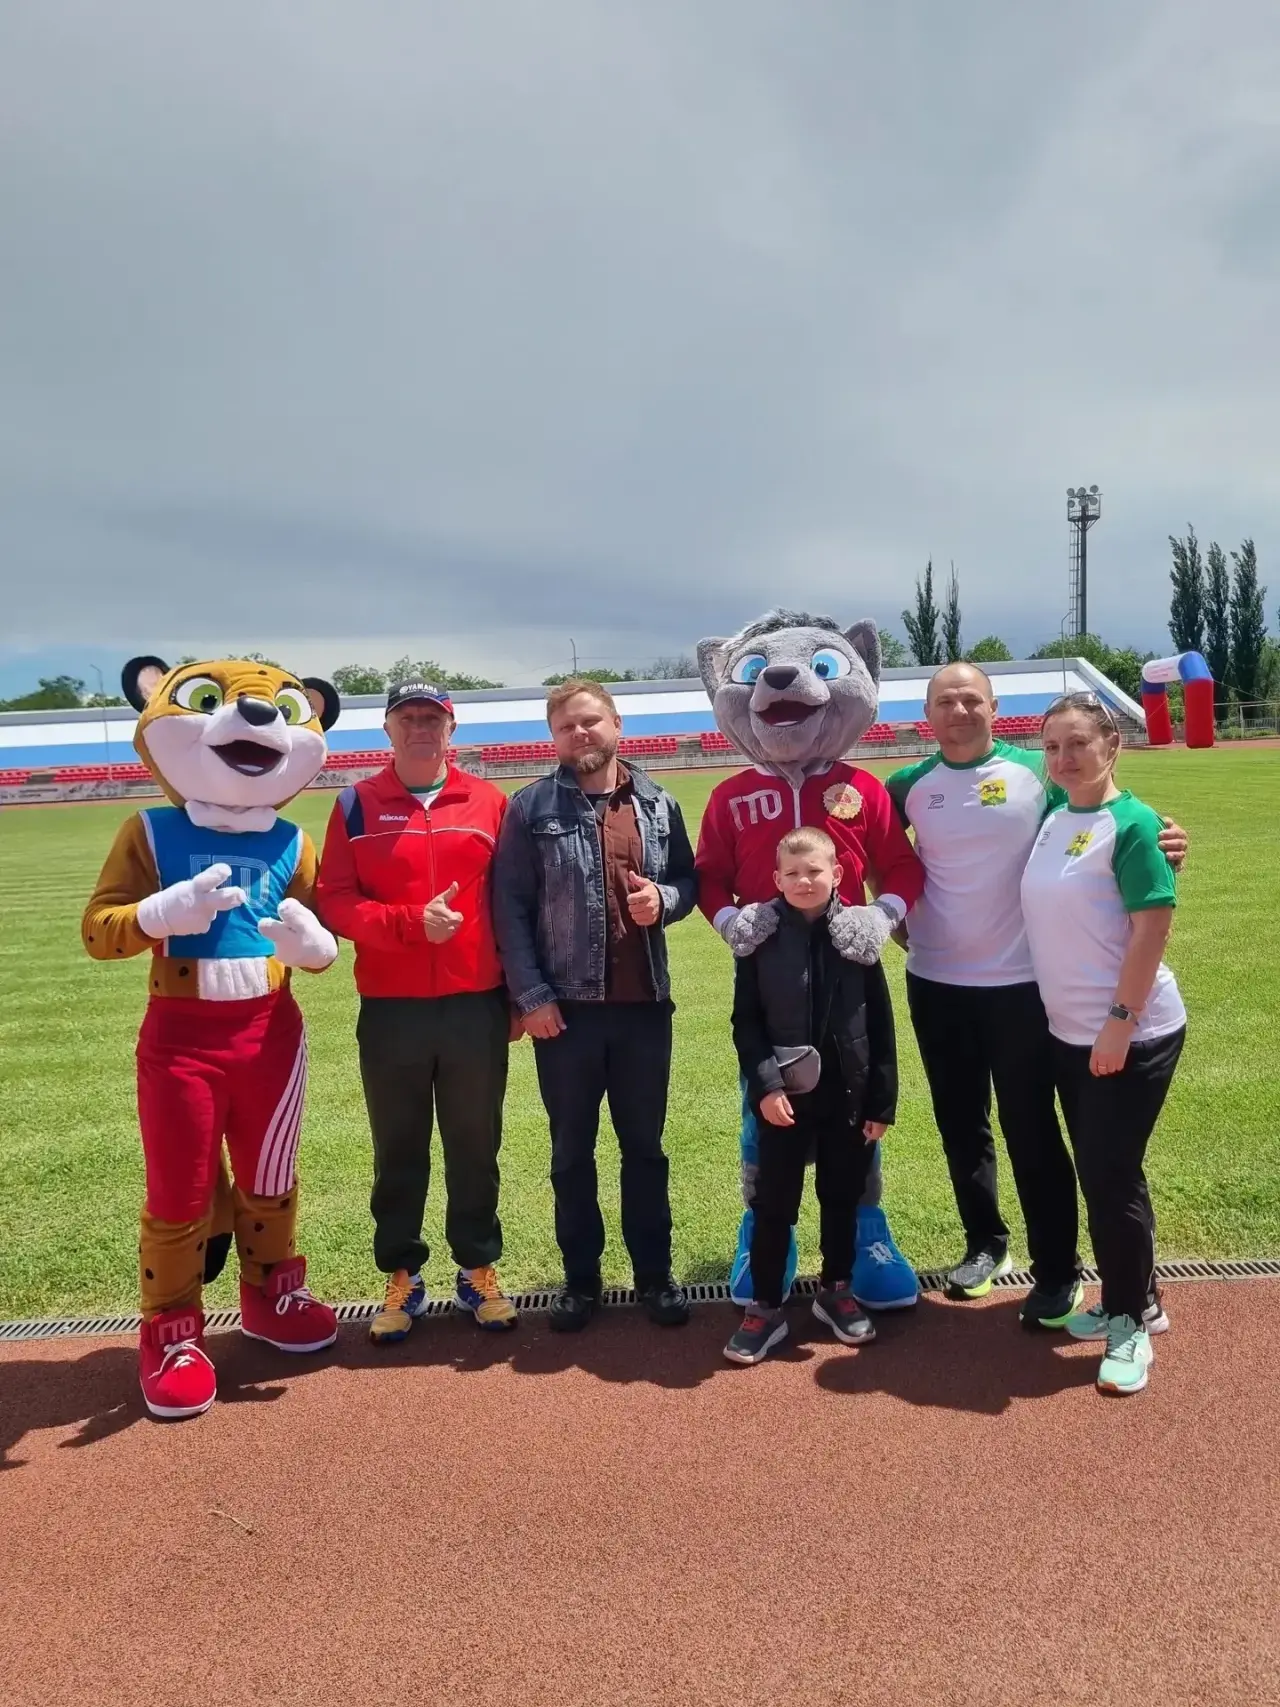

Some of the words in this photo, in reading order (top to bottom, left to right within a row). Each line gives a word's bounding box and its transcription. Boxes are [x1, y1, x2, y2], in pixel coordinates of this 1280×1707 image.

[408, 683, 438, 694] YAMAHA
[728, 789, 783, 831] ГТО
[158, 1316, 195, 1344] ГТО
